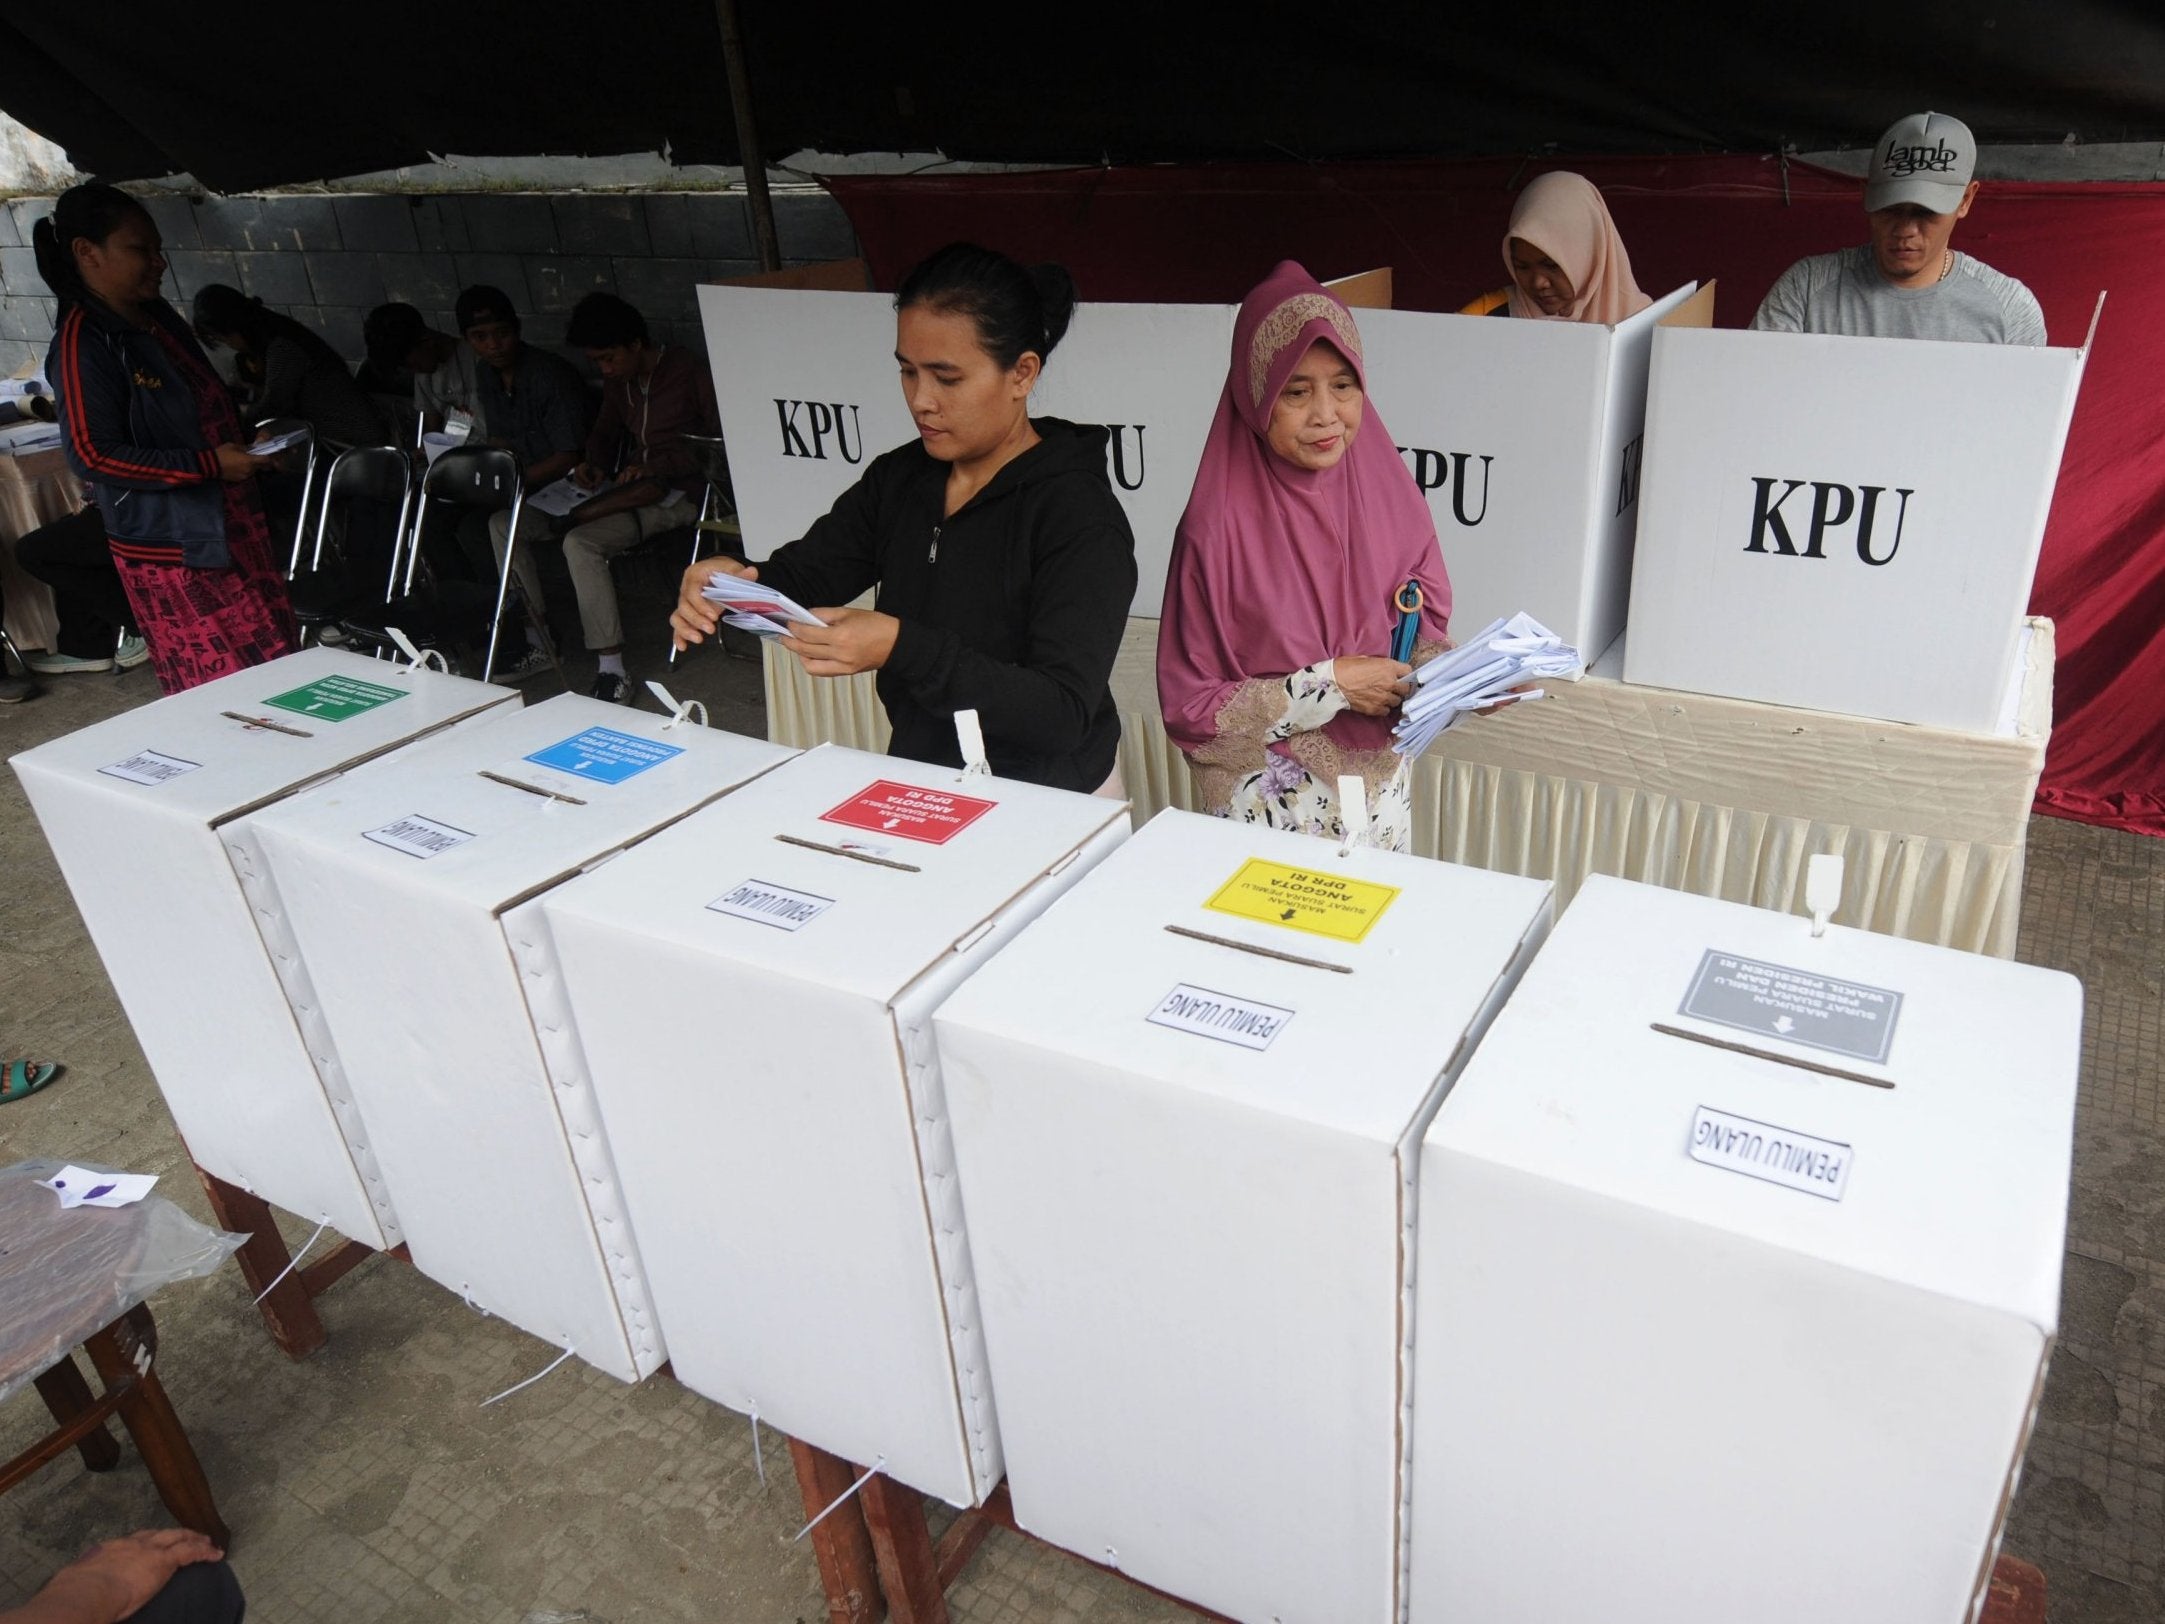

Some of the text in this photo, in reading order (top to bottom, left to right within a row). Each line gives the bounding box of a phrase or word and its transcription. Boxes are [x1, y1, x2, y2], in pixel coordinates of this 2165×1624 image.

[1884, 138, 1957, 167] lamb
[773, 399, 862, 464] KPU
[1396, 446, 1494, 526] PU
[1743, 477, 1915, 566] KPU
[883, 795, 956, 814] ANGGOTA
[921, 794, 955, 804] DPD
[1239, 882, 1367, 915] SURAT SUARA PEMILU
[1268, 878, 1353, 902] ANGGOTA
[1289, 873, 1347, 890] DPR RI
[1266, 896, 1327, 914] MASUKAN
[1719, 959, 1885, 1003] WAKIL PRESIDEN RI
[1736, 972, 1860, 1007] PRESIDEN DAN
[1713, 976, 1877, 1021] SURAT SUARA PEMILU
[1752, 994, 1829, 1019] MASUKAN
[1160, 994, 1281, 1039] PEMILU ULANG
[1696, 1120, 1842, 1184] PEMILU ULANG
